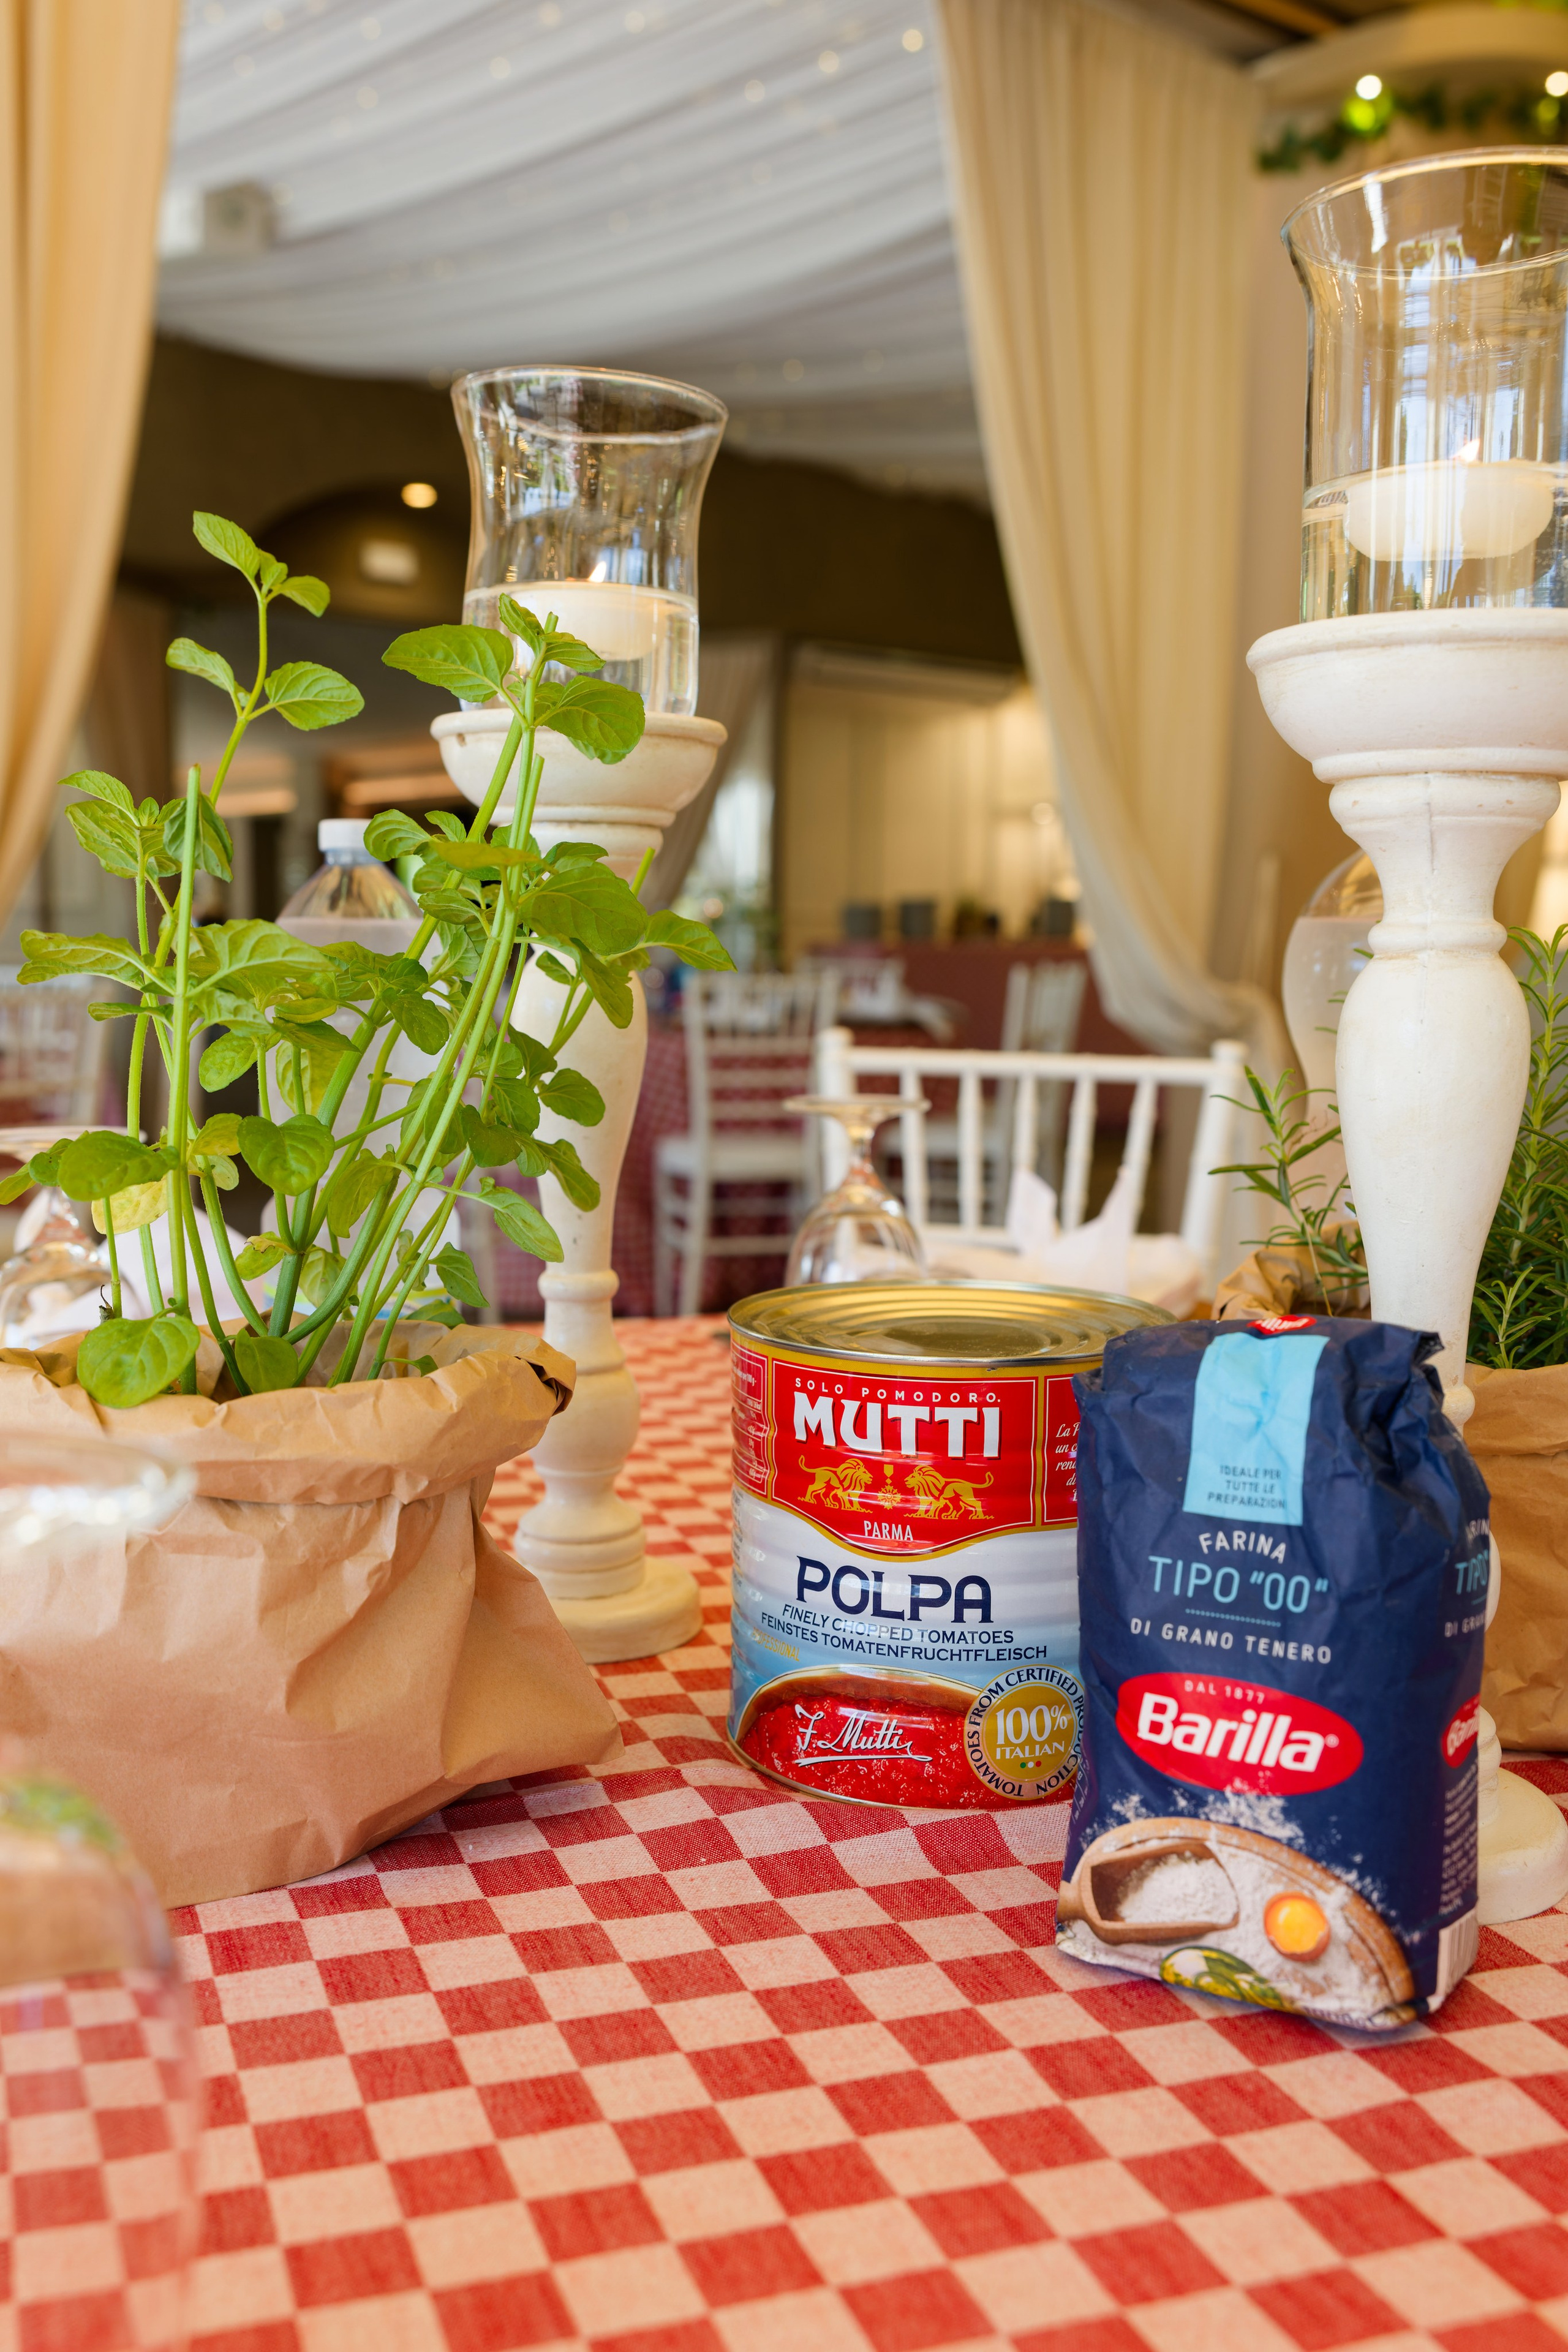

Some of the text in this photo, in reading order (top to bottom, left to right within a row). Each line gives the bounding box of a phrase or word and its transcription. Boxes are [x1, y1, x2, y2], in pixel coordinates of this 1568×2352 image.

[795, 1378, 843, 1395] SOLO
[793, 1391, 1001, 1460] MUTTI
[1056, 1423, 1071, 1438] La
[1055, 1444, 1069, 1453] un
[1219, 1464, 1281, 1480] IDEALE PER
[1226, 1480, 1275, 1494] TUTTE LE
[864, 1520, 914, 1542] PARMA
[1199, 1530, 1286, 1564] FARINA
[796, 1556, 994, 1623] POLPA
[1148, 1555, 1240, 1604] TIPO
[761, 1613, 1047, 1662] FEINSTES TOMATENFRUCHTFLEISCH
[782, 1604, 1014, 1645] FINELY CHOPPED TOMATOES
[1130, 1618, 1332, 1664] DI GRANO TENERO
[1005, 1667, 1077, 1697] CERTIFIED
[1184, 1679, 1265, 1705] DAL 1877
[968, 1681, 1005, 1727] FROM
[816, 1711, 914, 1753] Mutti
[996, 1705, 1068, 1745] 100%
[967, 1730, 1025, 1797] TOMATOES
[996, 1741, 1065, 1760] ITALIAN
